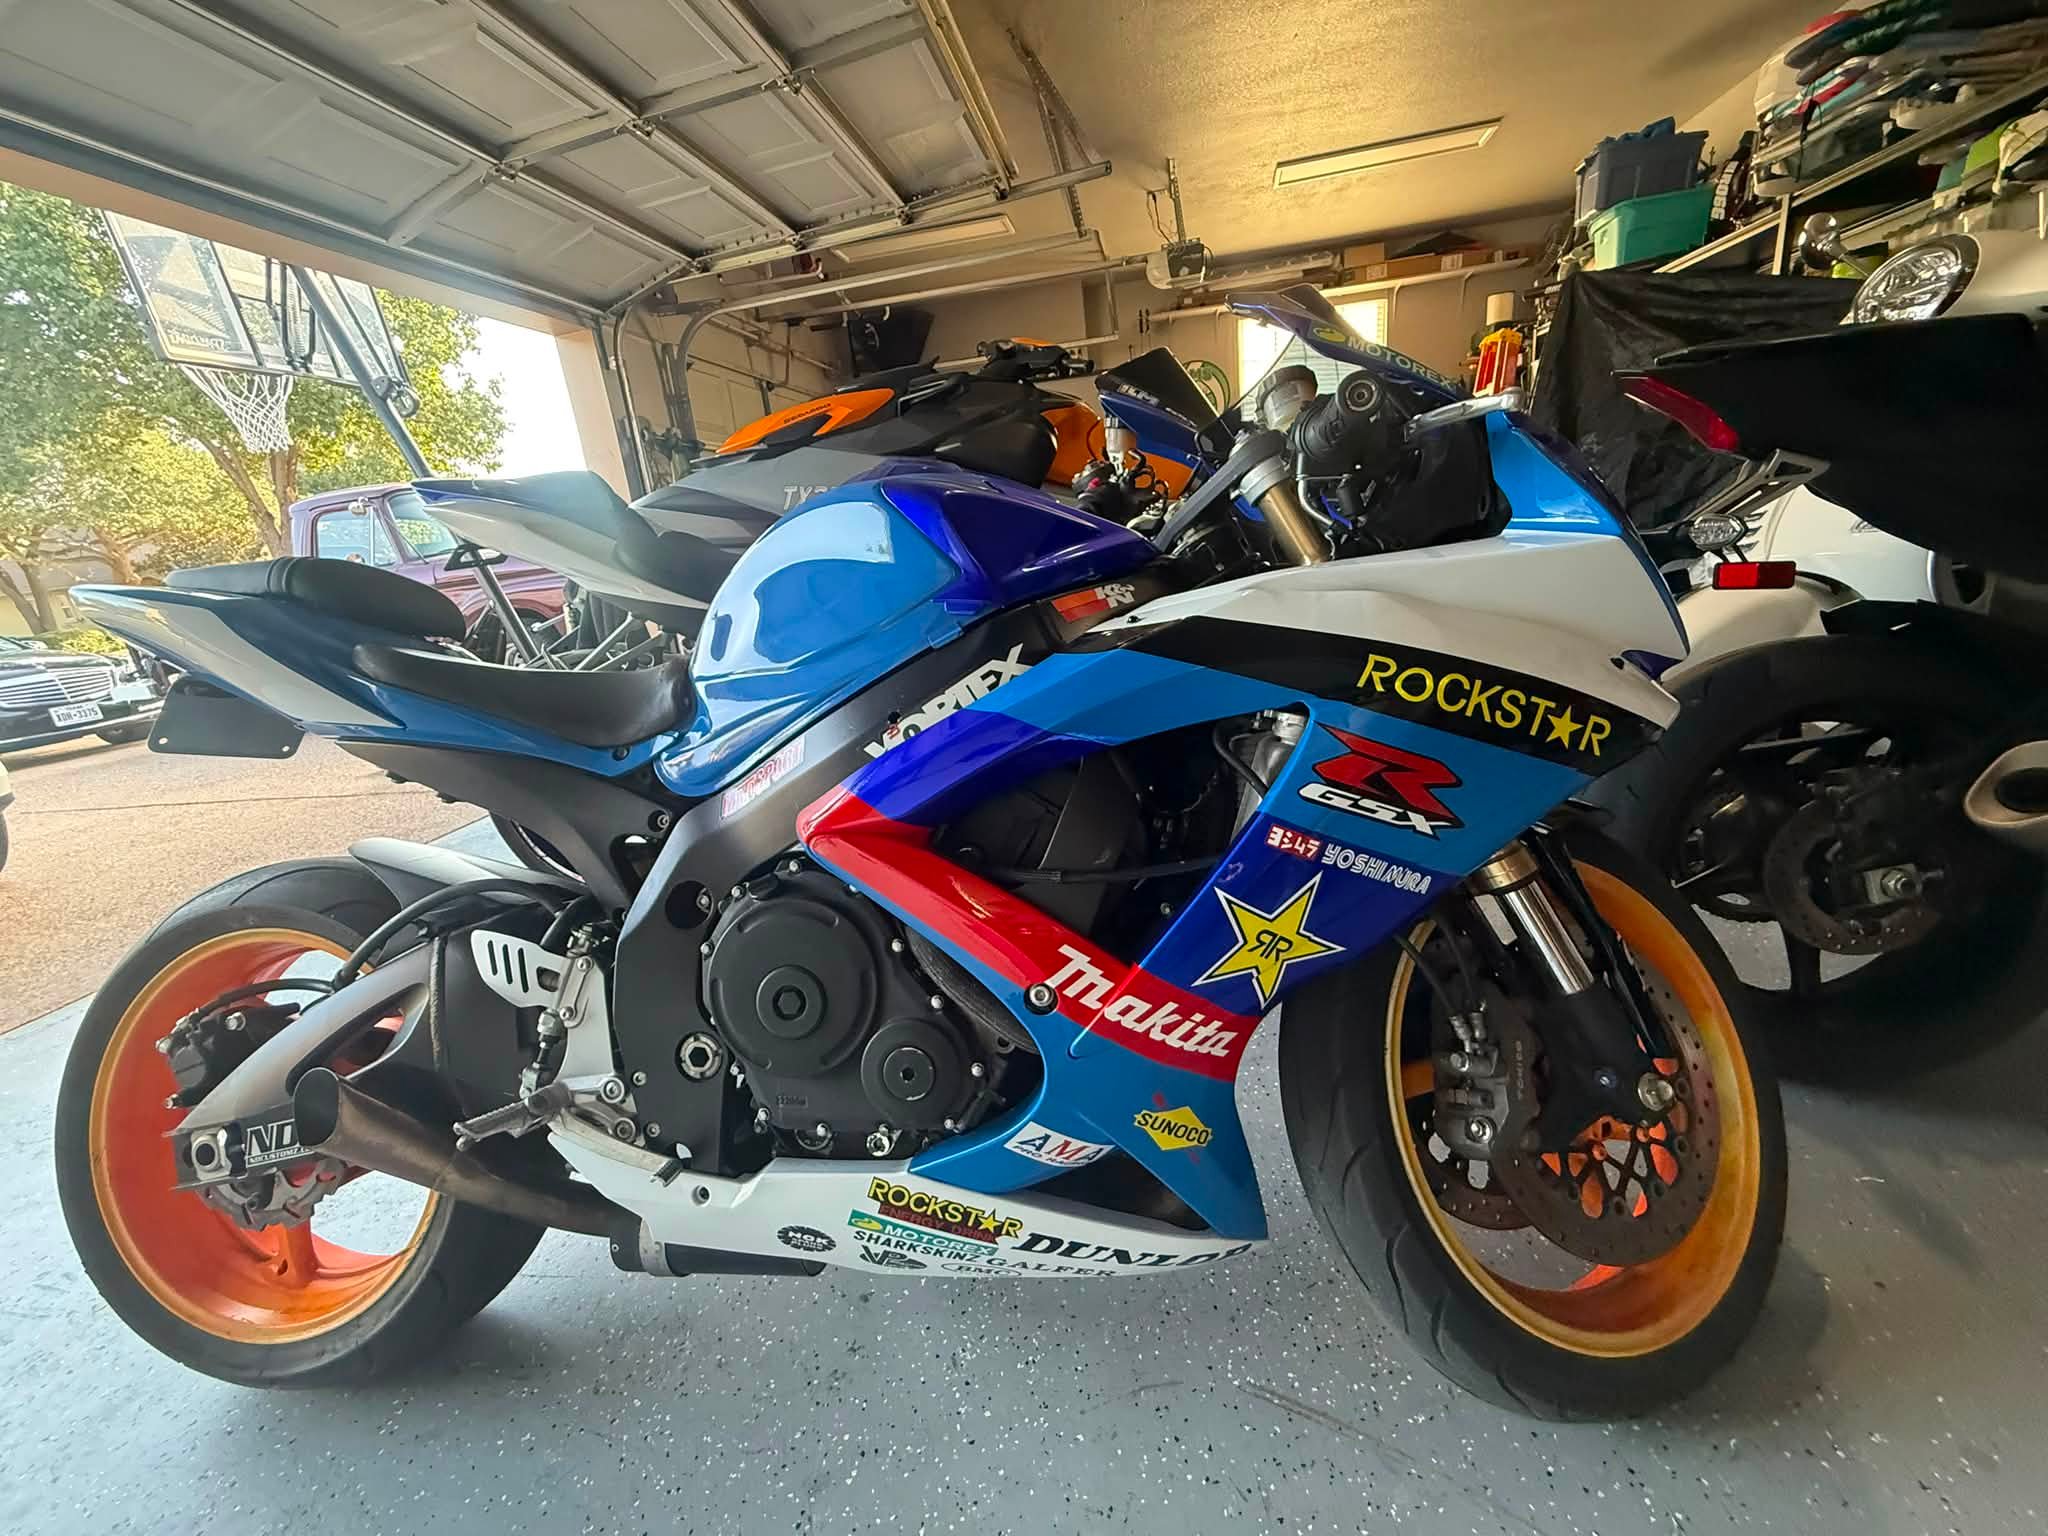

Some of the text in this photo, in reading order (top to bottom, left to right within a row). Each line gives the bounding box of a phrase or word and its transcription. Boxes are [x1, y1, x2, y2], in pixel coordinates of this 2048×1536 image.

[1346, 335, 1457, 389] MOTOREX
[863, 642, 1033, 759] VORTEX
[1299, 782, 1456, 836] GSX
[1321, 843, 1432, 896] YOSHIMURA
[1043, 943, 1239, 1057] Makita
[1136, 1111, 1211, 1146] SUNOCO
[1015, 1132, 1105, 1162] AMA
[853, 1230, 981, 1263] SHARKSKINZ
[884, 1225, 994, 1255] MOTOREX
[1011, 1232, 1252, 1267] DUNLOP
[986, 1257, 1117, 1277] GALFER
